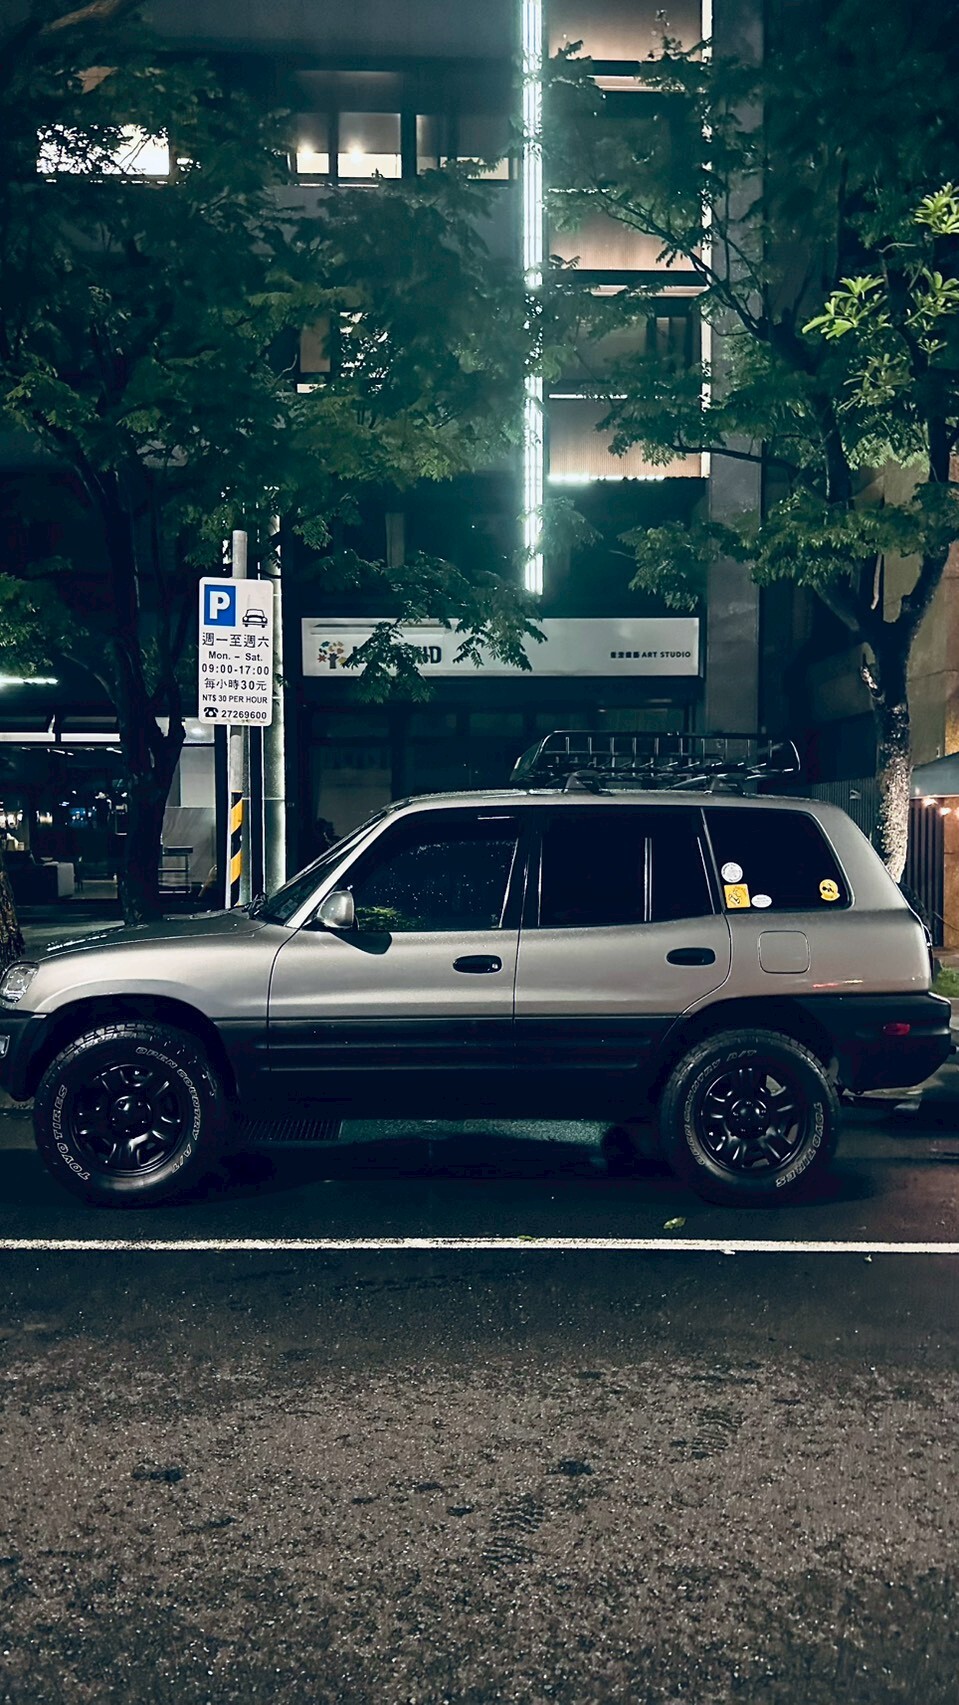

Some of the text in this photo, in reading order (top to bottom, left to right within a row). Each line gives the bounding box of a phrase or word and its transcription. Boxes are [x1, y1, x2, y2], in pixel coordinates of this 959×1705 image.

[209, 590, 231, 620] P
[202, 632, 270, 648] 週一至週六
[208, 651, 231, 660] Mon.
[245, 653, 263, 661] Sat.
[201, 663, 270, 675] 09:00-17:00
[204, 678, 267, 691] 每小時30元
[202, 694, 217, 702] NT$
[229, 695, 244, 703] PER
[245, 696, 268, 704] HOUR
[221, 710, 267, 719] 27269600
[136, 1046, 178, 1069] OPEN
[177, 1068, 201, 1141] COUNTRY
[52, 1084, 91, 1181] TOYO TIRES
[775, 1101, 824, 1188] TOYO TIRES
